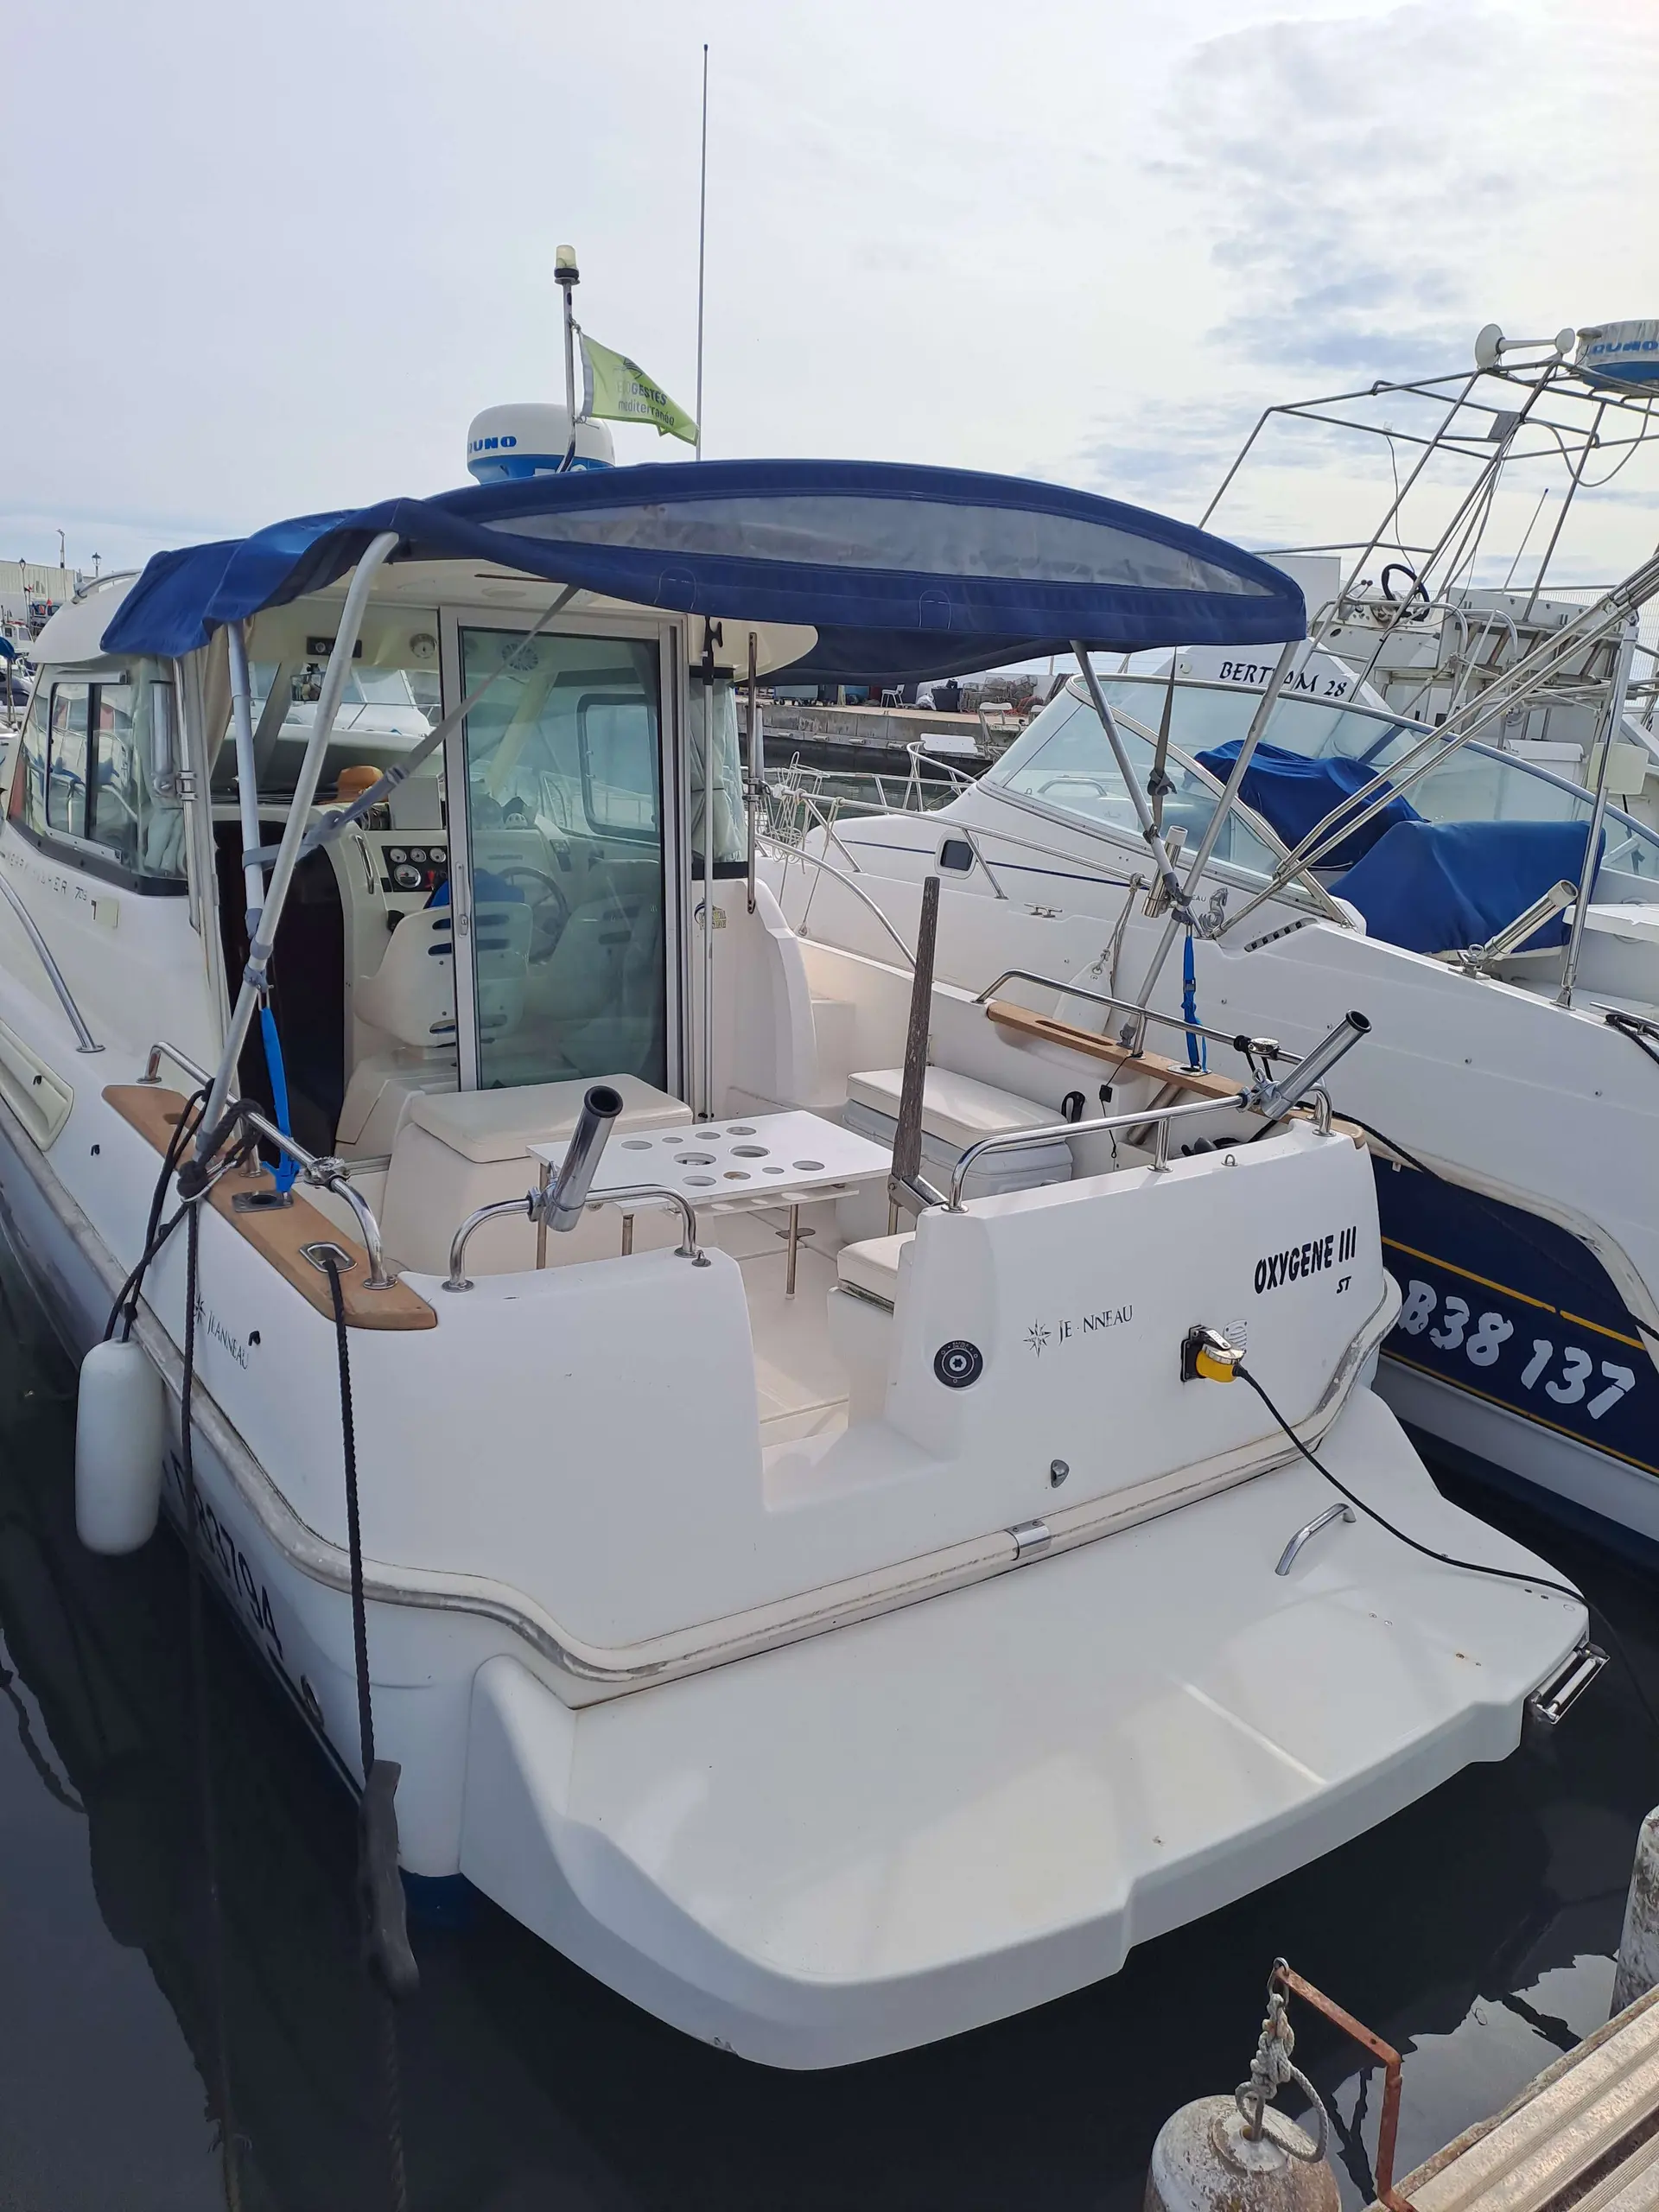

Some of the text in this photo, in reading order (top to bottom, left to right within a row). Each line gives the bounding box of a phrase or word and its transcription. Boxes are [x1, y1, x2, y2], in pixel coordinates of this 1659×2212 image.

[1219, 661, 1348, 697] BERTAM 28
[1254, 1225, 1357, 1294] OXYGENE III
[1336, 1275, 1352, 1294] ST
[1058, 1304, 1133, 1347] JENNEAU
[1397, 1280, 1637, 1421] B38 137
